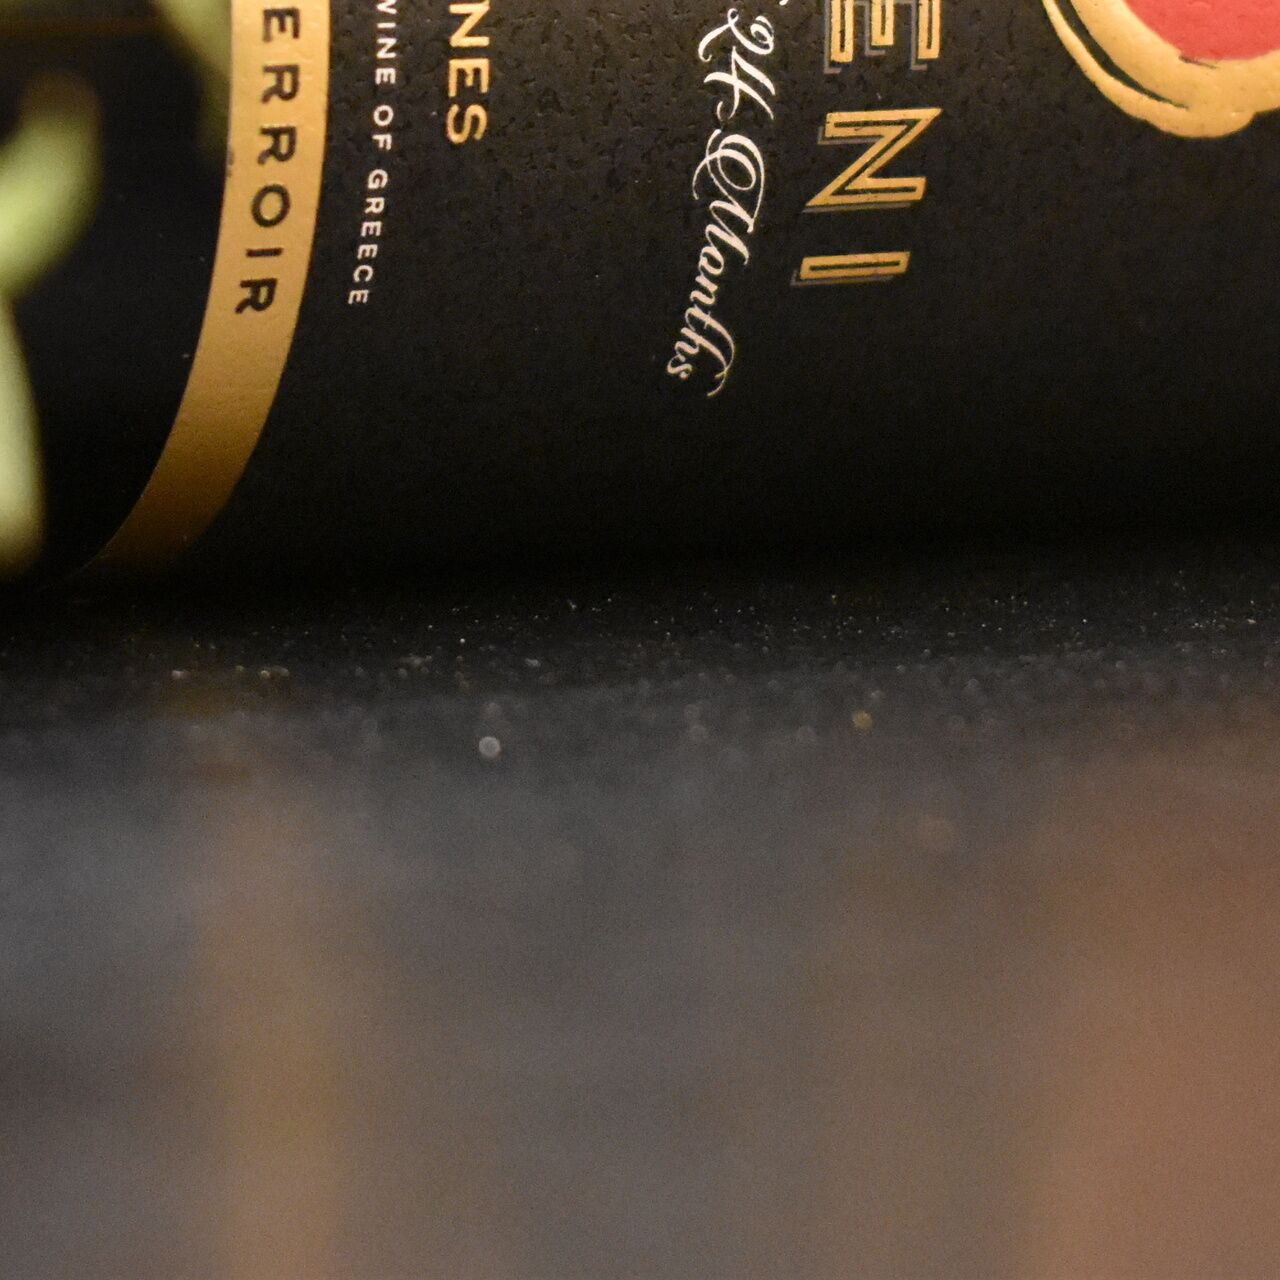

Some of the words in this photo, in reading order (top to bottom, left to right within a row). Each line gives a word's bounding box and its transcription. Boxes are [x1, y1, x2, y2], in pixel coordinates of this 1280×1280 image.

[697, 7, 777, 121] 24
[370, 104, 395, 151] OF
[347, 168, 389, 307] GREECE
[665, 128, 765, 398] Months
